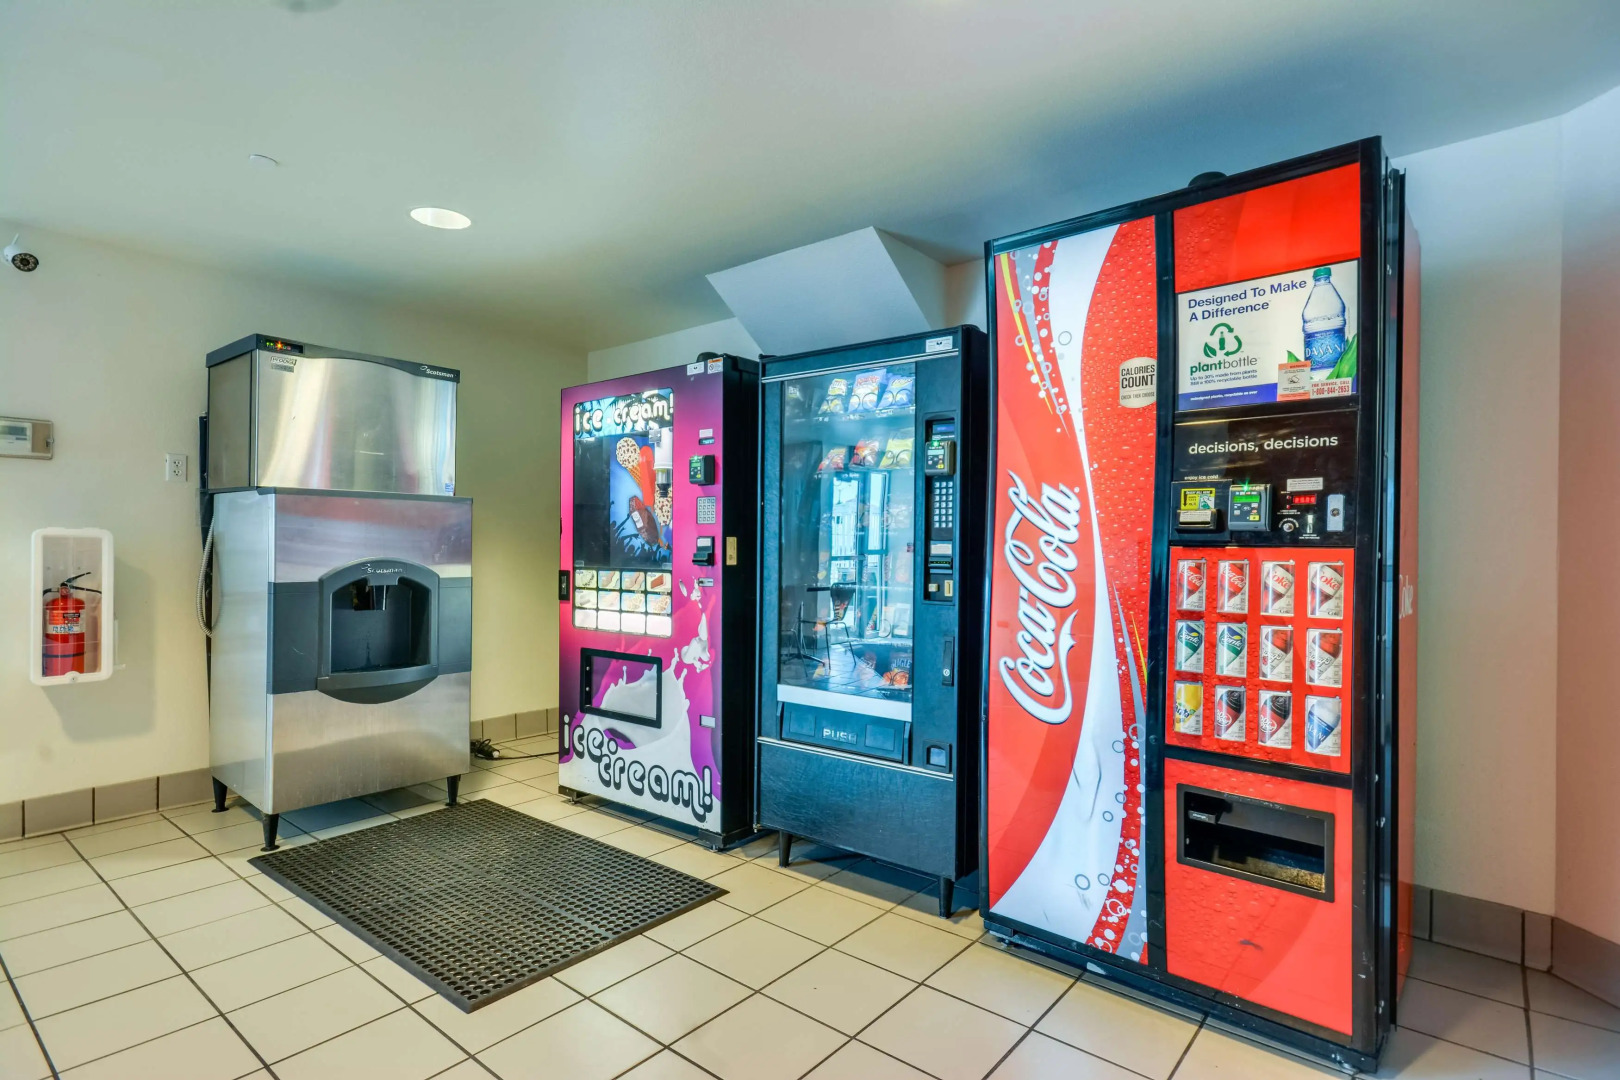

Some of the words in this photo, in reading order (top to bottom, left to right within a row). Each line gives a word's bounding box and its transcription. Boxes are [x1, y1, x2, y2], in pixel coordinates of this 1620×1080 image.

[1188, 289, 1247, 309] Designed
[1251, 287, 1266, 298] To
[1270, 280, 1307, 295] Make
[1189, 312, 1198, 322] A
[1202, 301, 1270, 320] Difference
[426, 369, 454, 378] Scotsman
[1121, 364, 1156, 377] CALORIES
[1190, 355, 1258, 377] plantbottle
[1121, 374, 1155, 389] COUNT
[575, 407, 603, 435] ice
[1188, 440, 1259, 455] decisions,
[1263, 435, 1339, 450] decisions
[998, 468, 1082, 725] Coca-Cola
[563, 714, 605, 764] ice
[823, 727, 857, 745] PUSH
[598, 753, 714, 823] cream!
